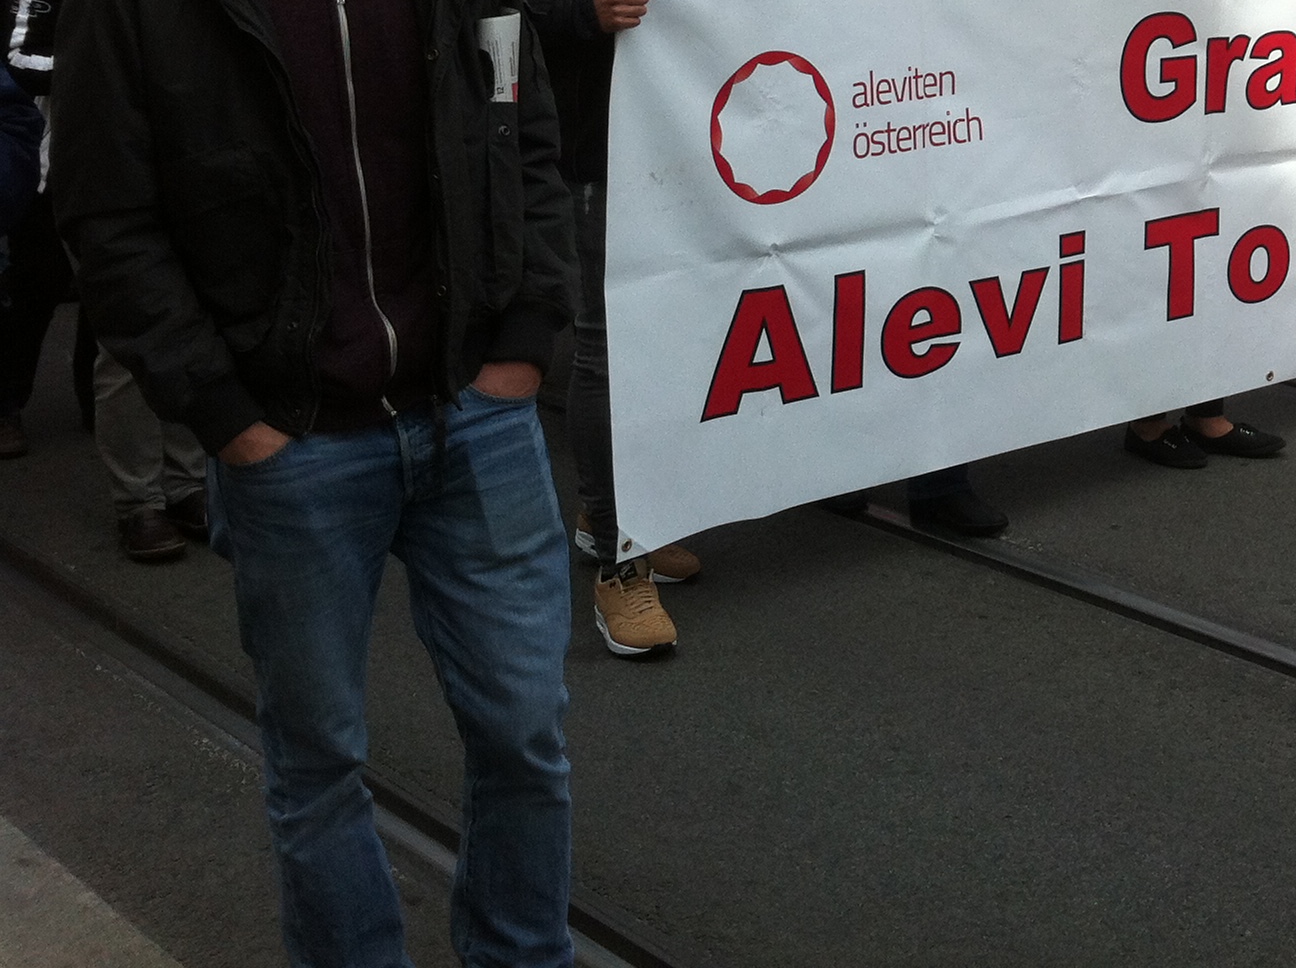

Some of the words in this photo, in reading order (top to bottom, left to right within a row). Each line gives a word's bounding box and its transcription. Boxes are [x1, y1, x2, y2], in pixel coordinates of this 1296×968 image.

[851, 65, 956, 111] aleviten
[851, 106, 985, 161] österreich
[700, 230, 1088, 424] Alevi
